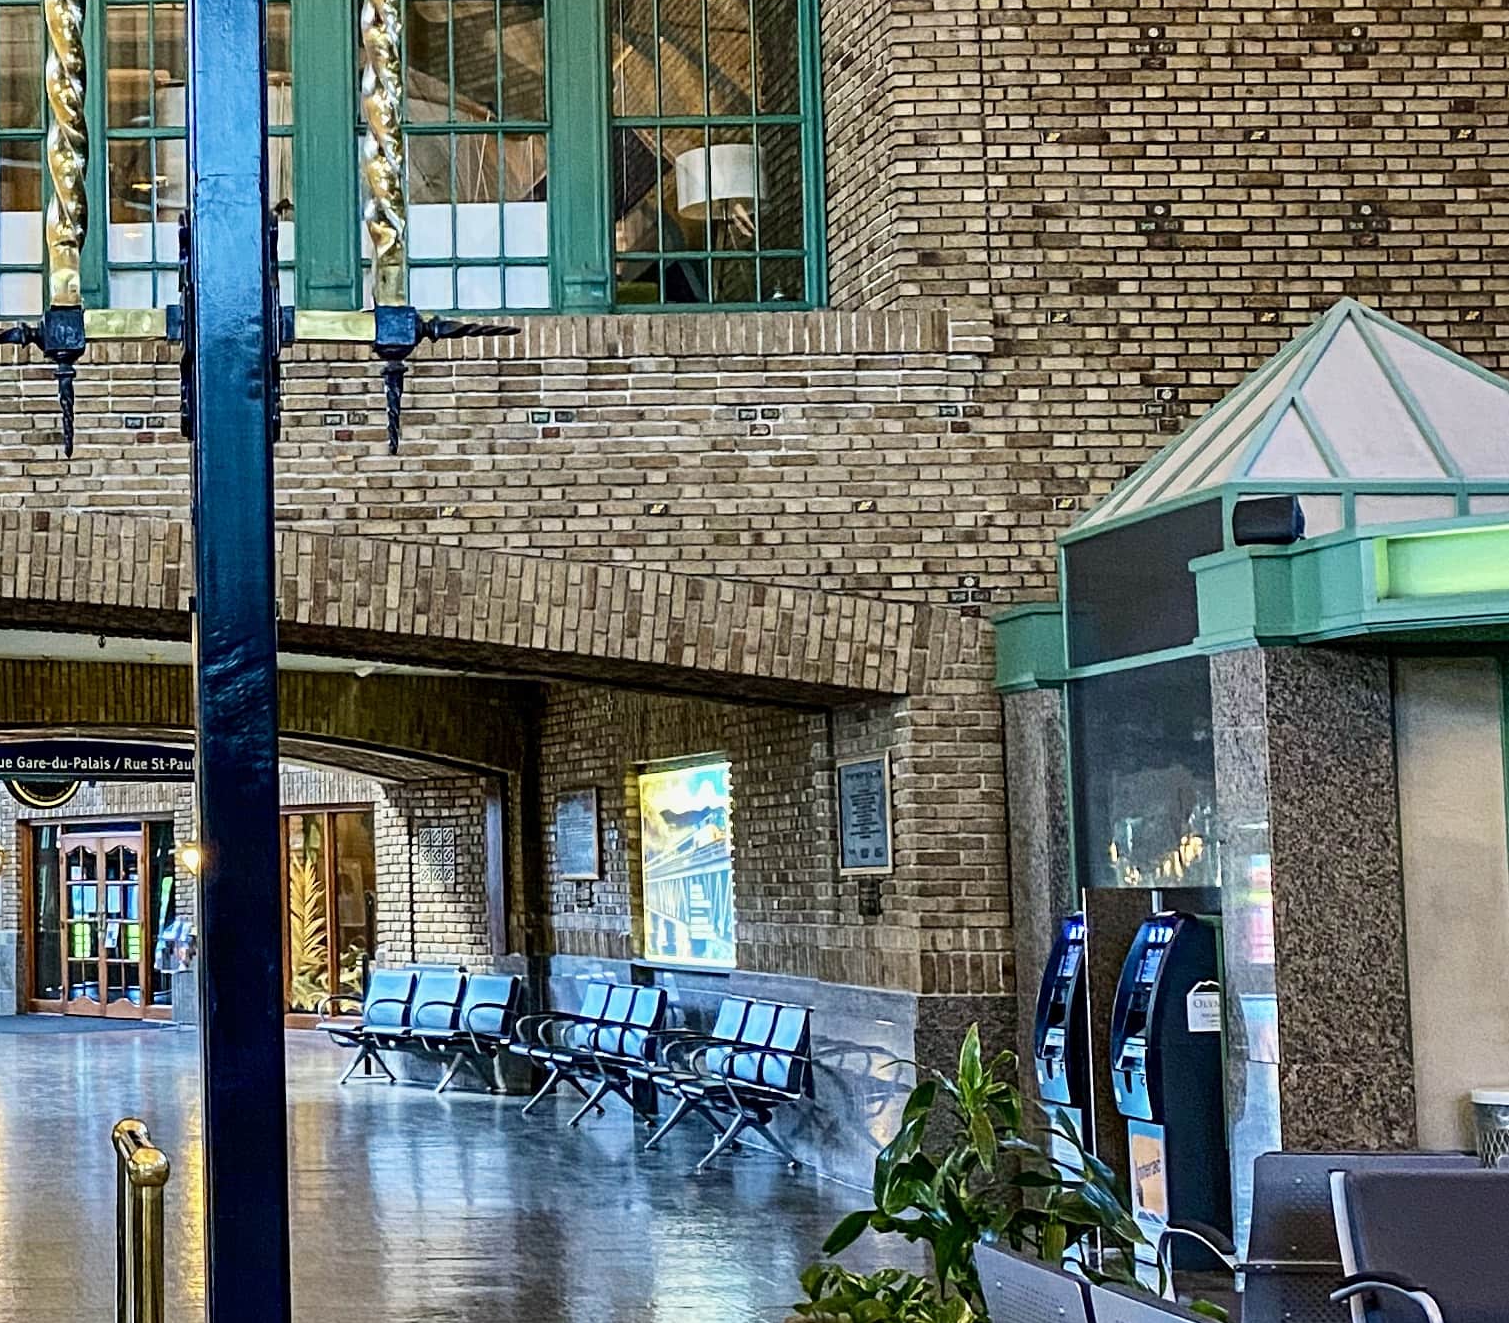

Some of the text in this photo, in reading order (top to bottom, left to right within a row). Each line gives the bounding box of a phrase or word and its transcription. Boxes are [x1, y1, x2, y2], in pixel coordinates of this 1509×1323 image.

[16, 756, 111, 770] Gare-du-Palais
[113, 757, 121, 770] /
[124, 757, 148, 770] Rue
[151, 757, 195, 770] St-Paul
